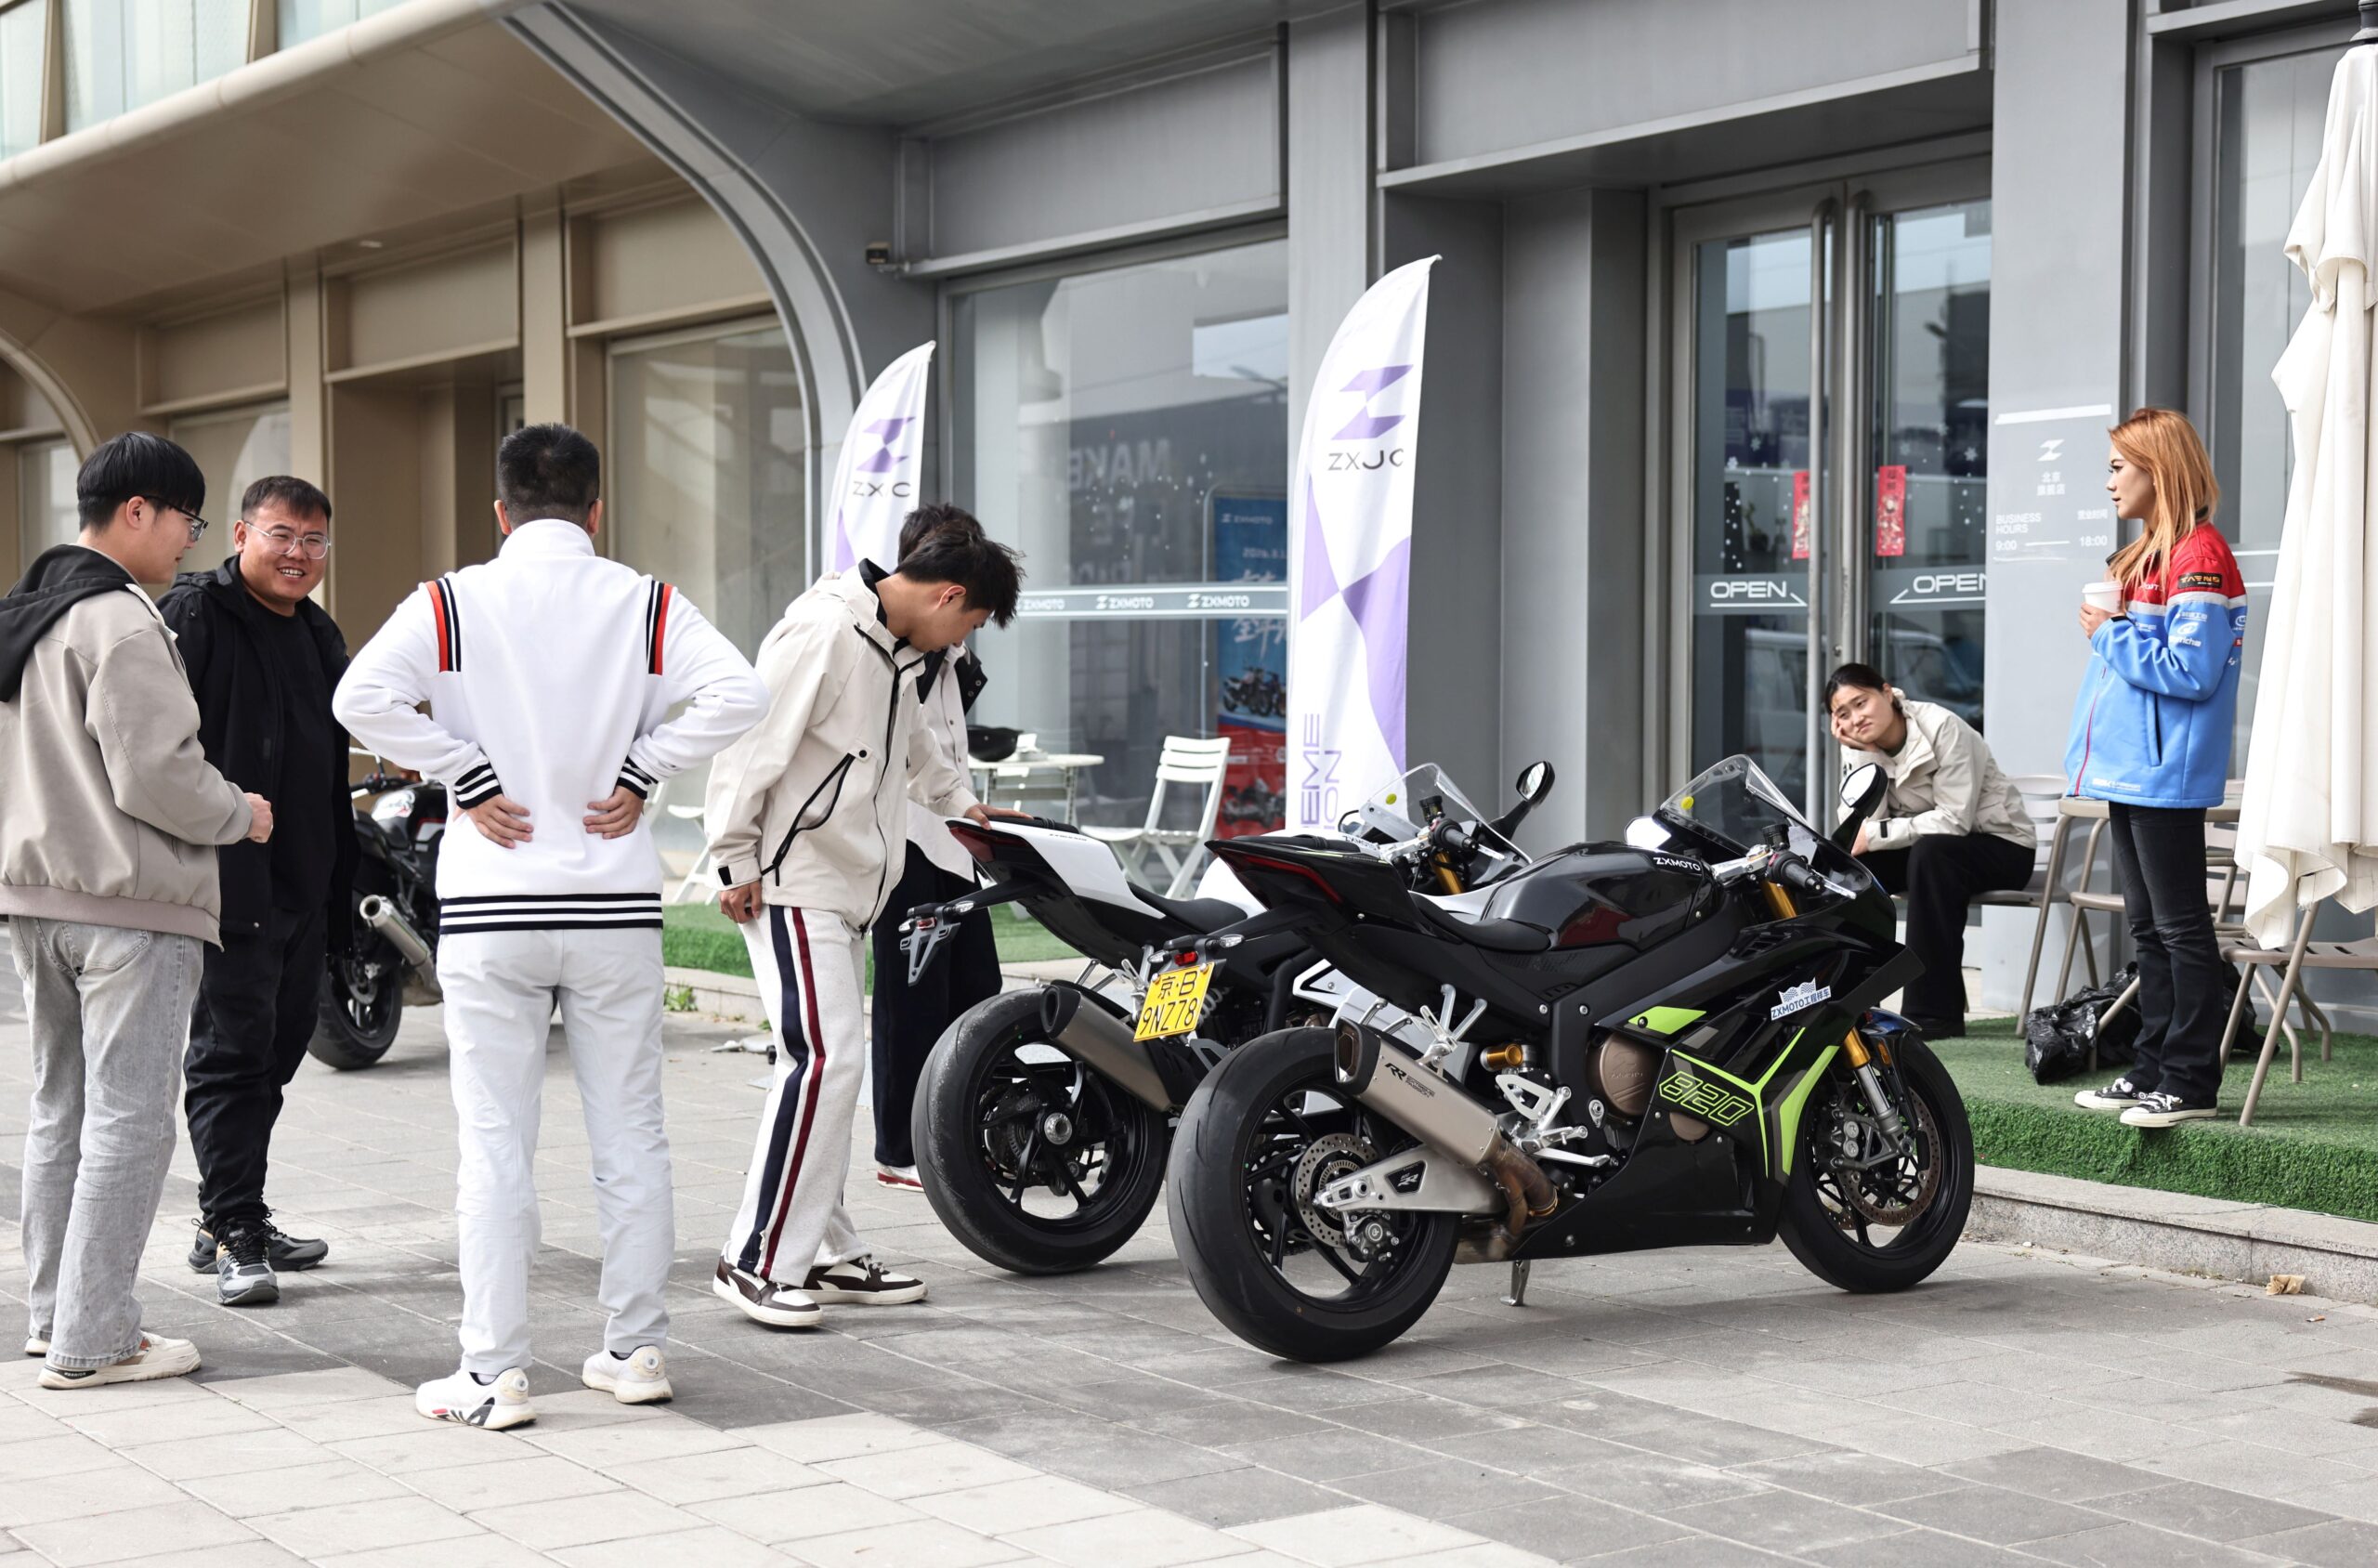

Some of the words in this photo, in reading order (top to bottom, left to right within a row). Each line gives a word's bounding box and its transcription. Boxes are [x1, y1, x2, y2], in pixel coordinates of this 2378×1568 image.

[853, 480, 911, 498] ZXC
[1995, 512, 2042, 525] BUSINESS
[1995, 523, 2029, 535] HOURS
[1995, 540, 2017, 551] 9:00
[2079, 535, 2108, 547] 18:00
[1710, 581, 1787, 599] OPEN
[1024, 597, 1065, 610] ZXMOTO
[1108, 595, 1155, 609] ZXMOTO
[1200, 595, 1250, 608] ZXMOTO
[1653, 856, 1701, 871] ZXMOTO
[1140, 998, 1198, 1036] 9NZ78
[1659, 1070, 1755, 1127] 820
